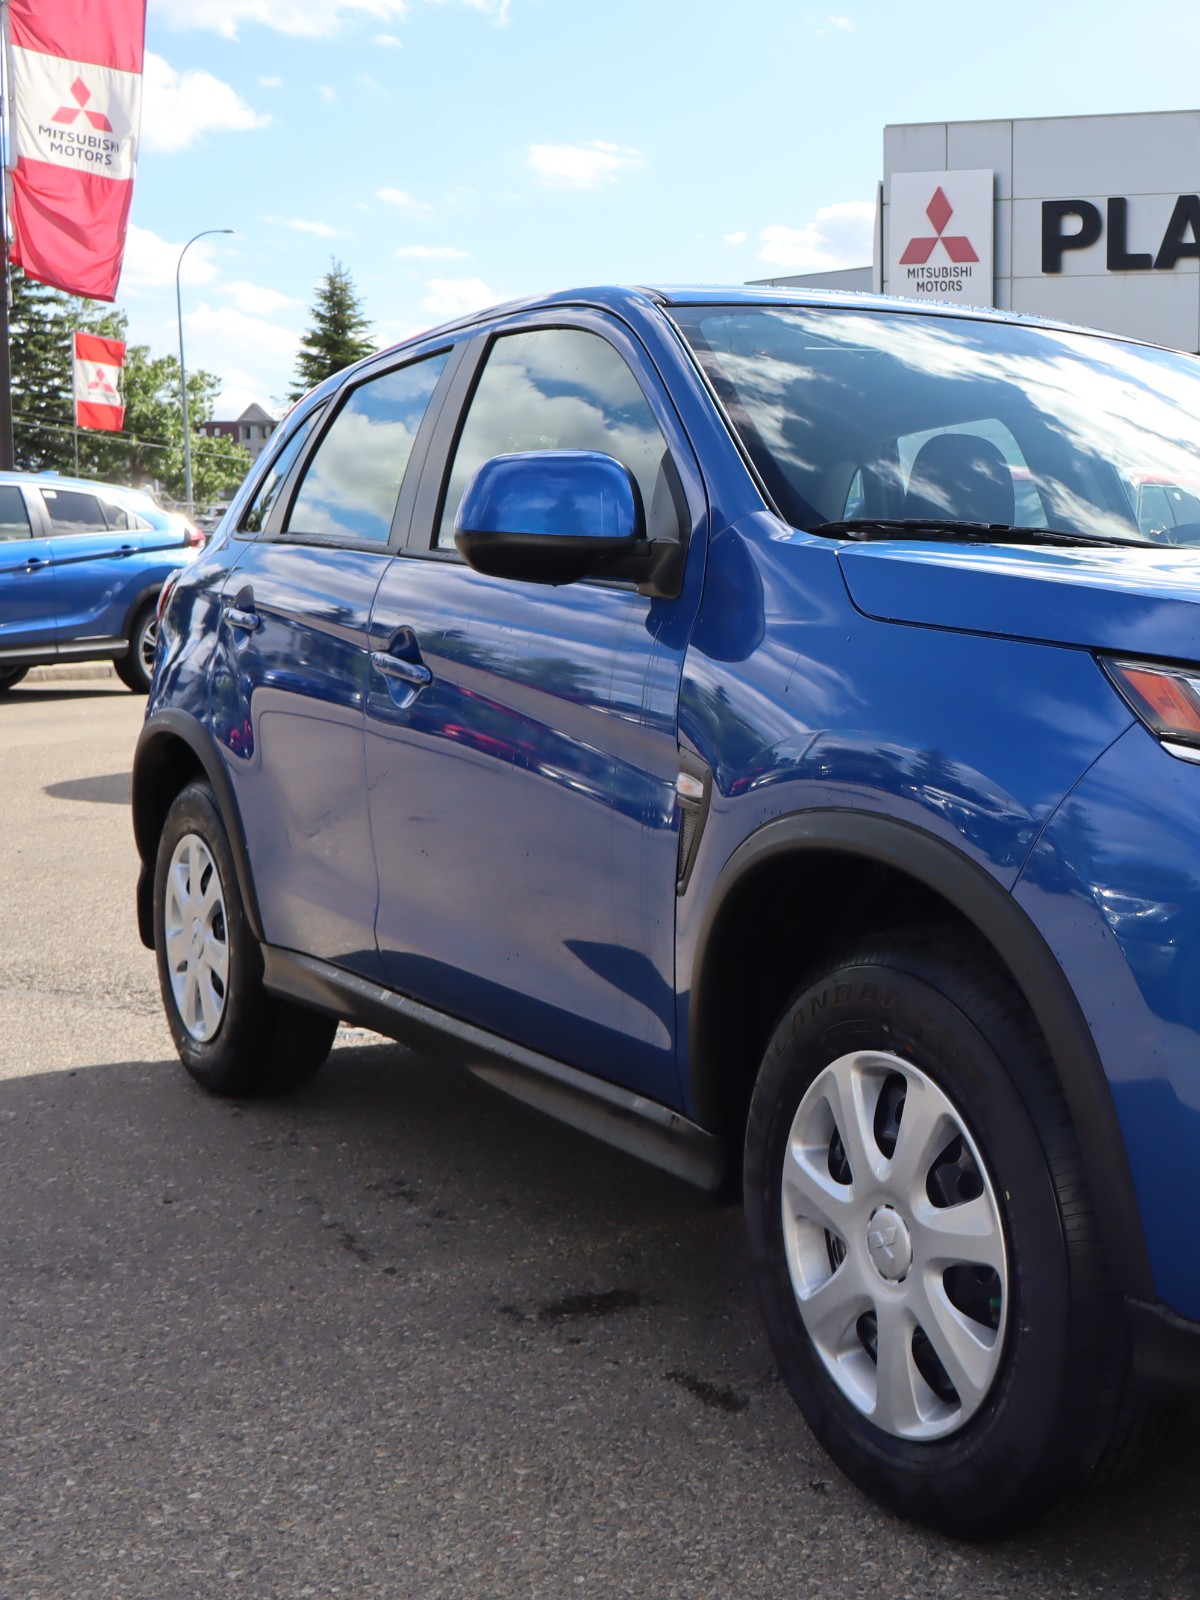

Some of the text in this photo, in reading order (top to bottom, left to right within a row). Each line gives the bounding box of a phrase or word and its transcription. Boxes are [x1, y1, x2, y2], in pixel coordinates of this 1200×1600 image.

[38, 124, 119, 153] MITSUBISHI
[50, 142, 112, 166] MOTORS
[906, 266, 973, 280] MITSUBISHI
[916, 280, 963, 293] MOTORS
